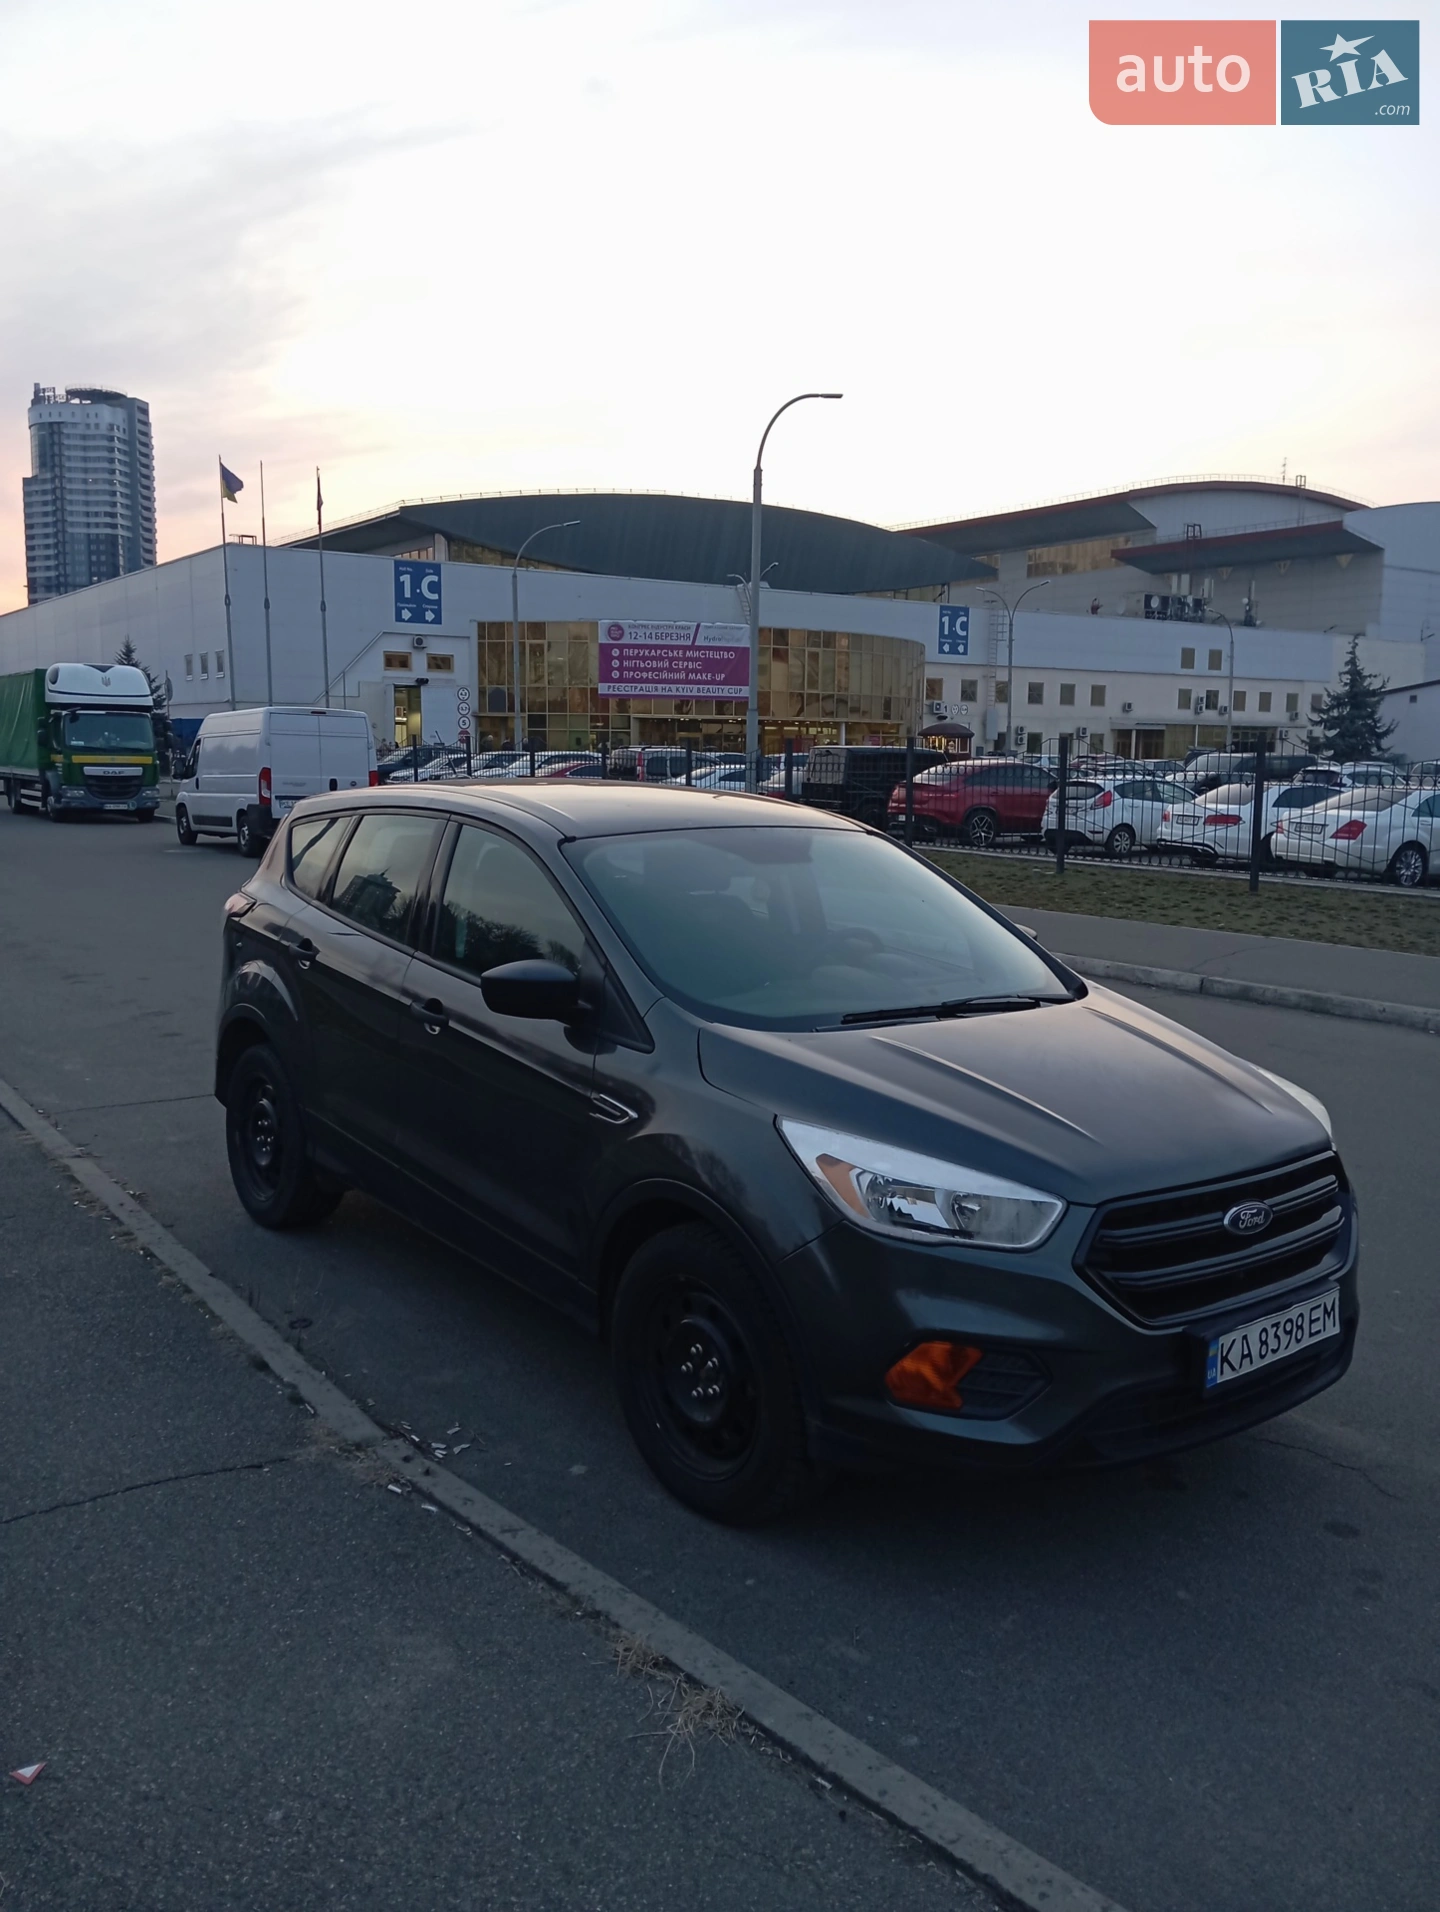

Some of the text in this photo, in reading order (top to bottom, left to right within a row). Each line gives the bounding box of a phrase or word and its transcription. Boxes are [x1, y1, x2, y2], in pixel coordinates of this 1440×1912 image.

[628, 631, 653, 640] 12-14
[654, 632, 691, 642] БЕРЕЗНЯ
[622, 648, 736, 660] ПЕРУКАРСЬКЕ МИСТЕЦТВО
[622, 659, 703, 669] НІГТЬОВИЙ СЕРВІС
[622, 670, 726, 681] ПРОФЕСІЙНИЙ MAKE-UP
[607, 685, 743, 695] РЕЄСТРАЦІЯ НА KYIV BEAUTY CUP
[1239, 1208, 1266, 1229] Ford
